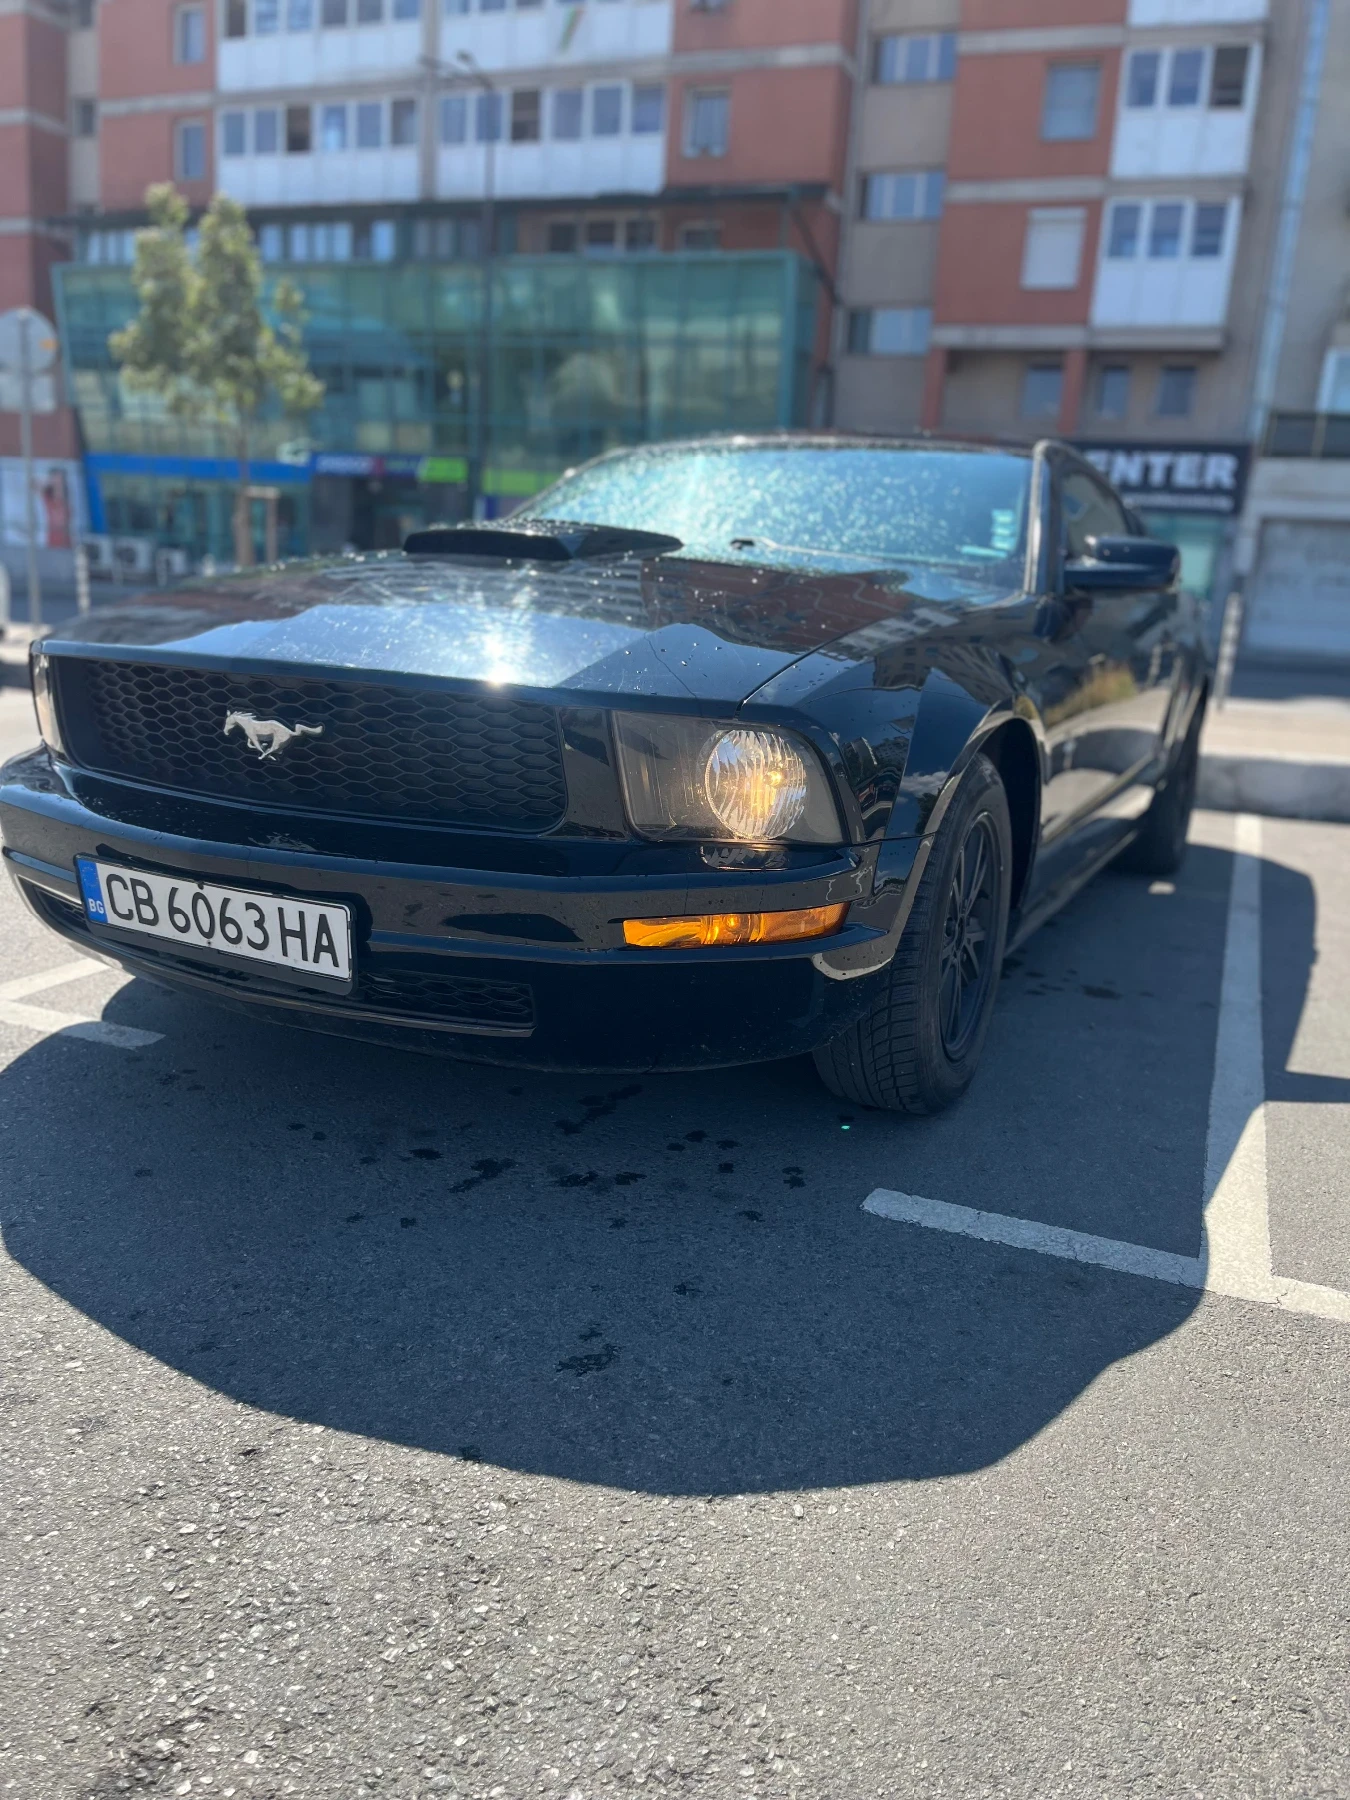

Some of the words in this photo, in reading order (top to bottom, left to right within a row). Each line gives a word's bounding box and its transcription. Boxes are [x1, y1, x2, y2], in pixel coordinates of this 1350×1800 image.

[87, 897, 105, 915] BG
[168, 886, 270, 951] 6063
[278, 906, 339, 968] HA
